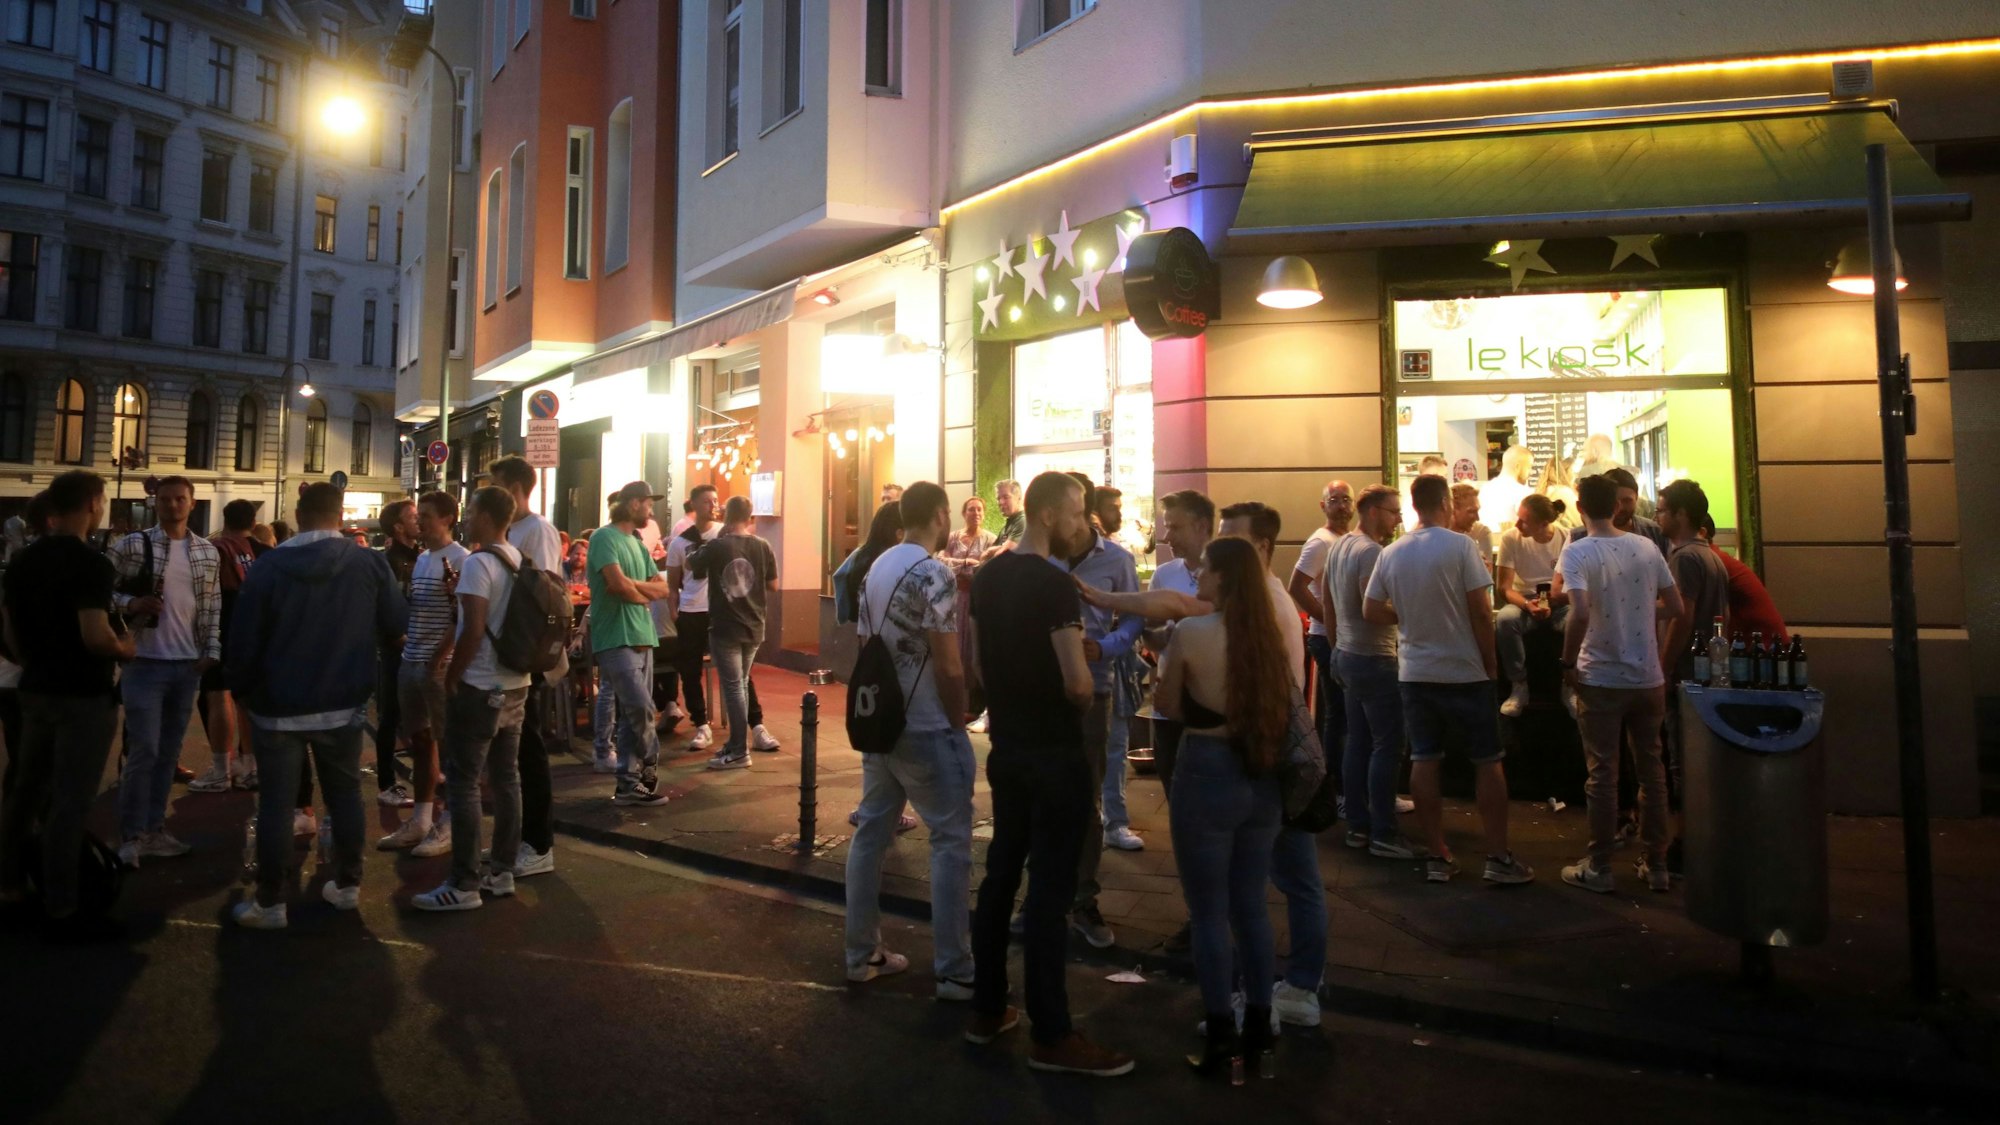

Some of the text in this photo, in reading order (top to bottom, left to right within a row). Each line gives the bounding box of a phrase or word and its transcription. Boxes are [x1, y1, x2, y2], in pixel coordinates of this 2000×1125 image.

[1165, 301, 1206, 328] Coffee
[1468, 332, 1650, 371] le kiosk
